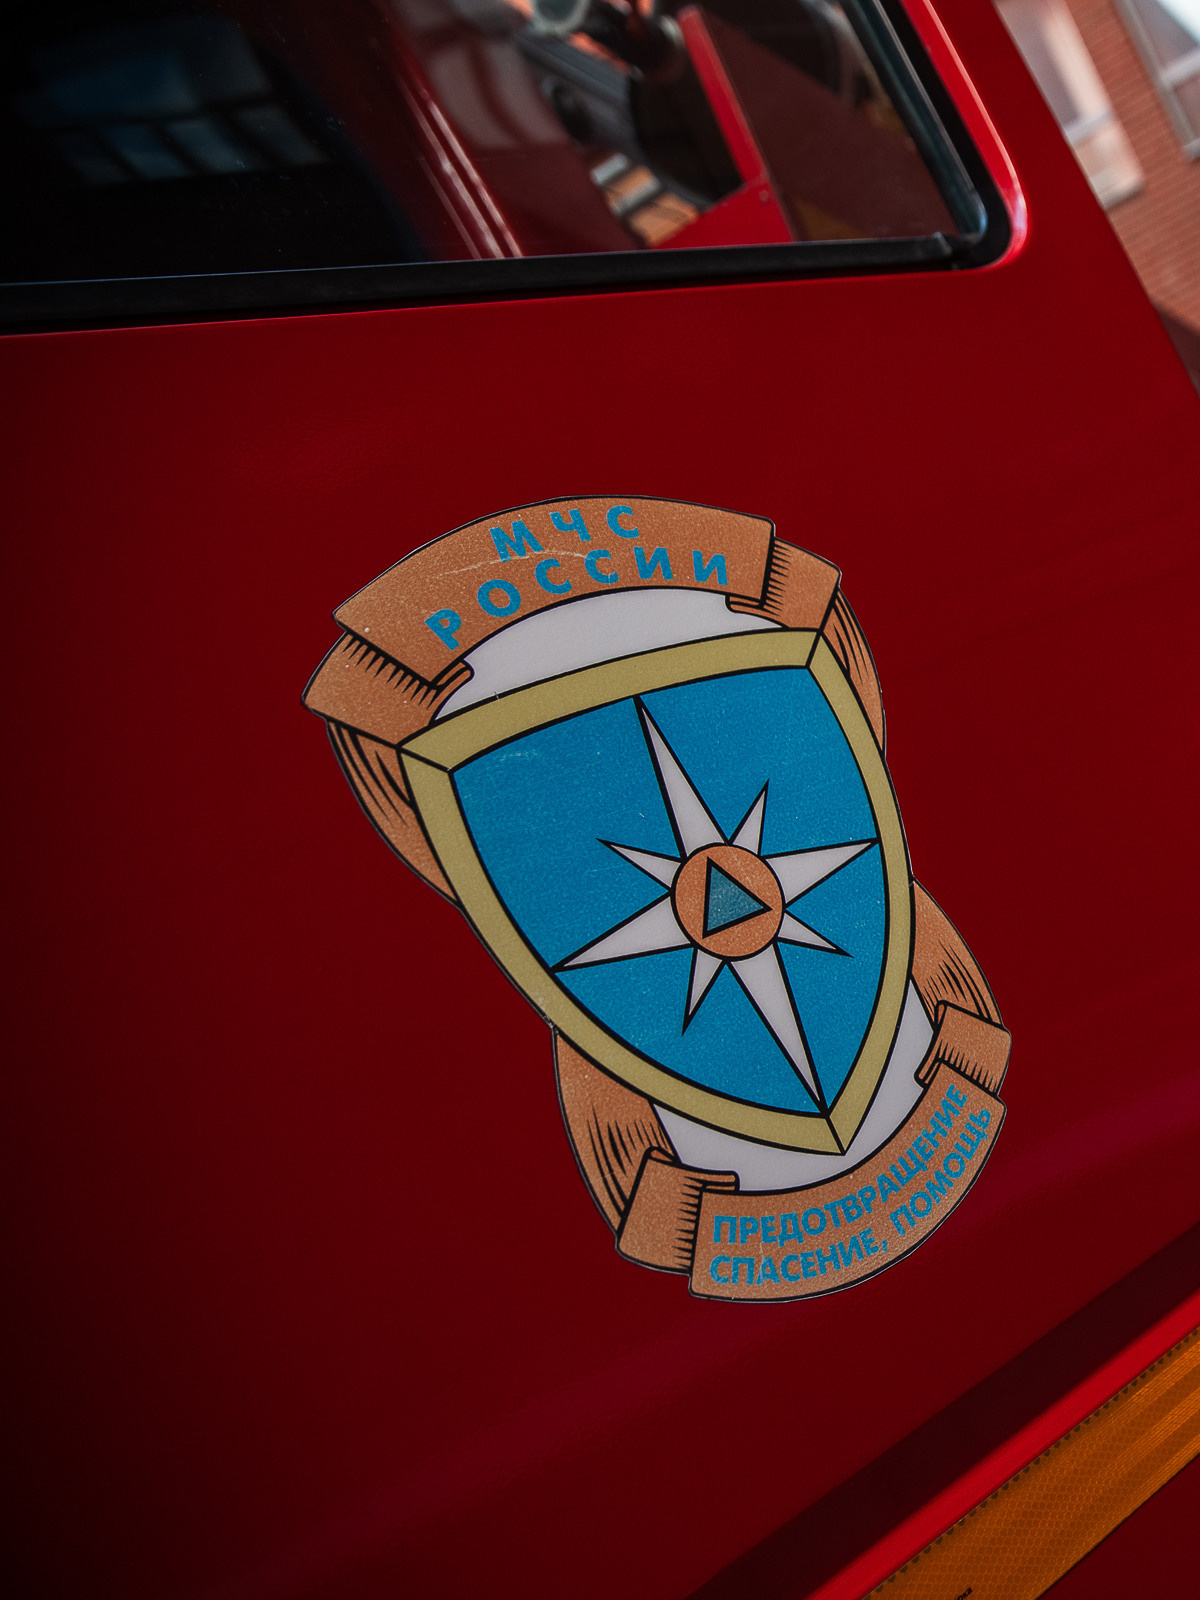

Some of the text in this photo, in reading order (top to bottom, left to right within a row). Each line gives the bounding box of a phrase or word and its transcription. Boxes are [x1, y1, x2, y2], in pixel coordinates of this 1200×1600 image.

[424, 547, 728, 650] РОССИИ
[489, 506, 640, 562] МЧС
[710, 1109, 991, 1285] СПАСЕНИЕ, ПОМОЩЬ
[713, 1084, 968, 1247] ПРЕДОТВРАЩЕНИЕ
